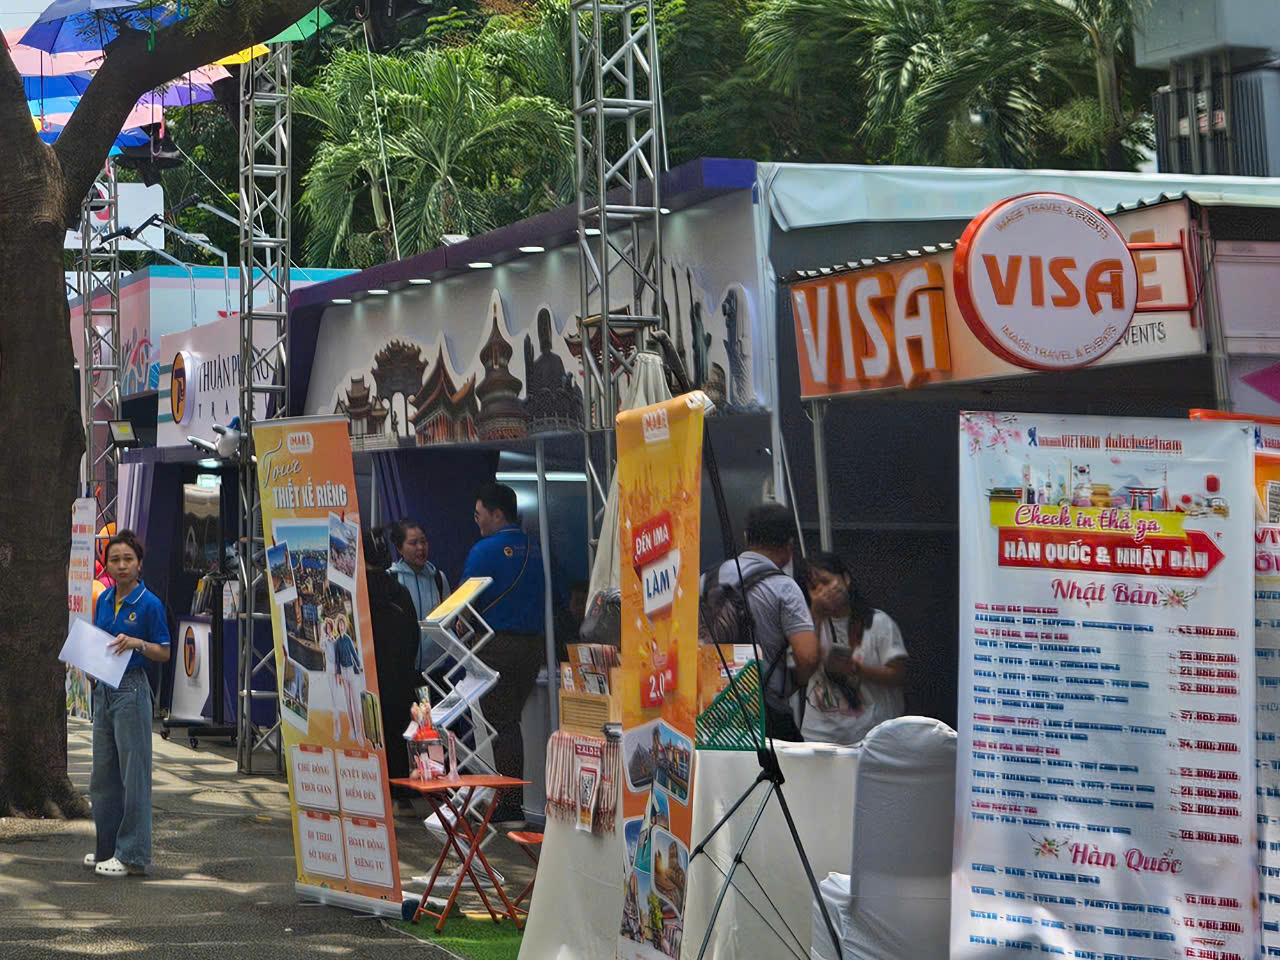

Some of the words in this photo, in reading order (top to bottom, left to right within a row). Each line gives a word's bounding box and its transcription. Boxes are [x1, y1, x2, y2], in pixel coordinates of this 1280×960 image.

[981, 253, 1126, 316] VISA
[794, 269, 946, 388] VISA
[262, 439, 302, 488] Tour
[272, 479, 300, 508] THIẾT
[301, 476, 315, 508] KẾ
[315, 479, 348, 508] RIÊNG
[635, 529, 652, 555] ĐẾN
[653, 524, 670, 546] IMA
[1014, 504, 1071, 527] Check
[1076, 511, 1095, 530] in
[1095, 507, 1132, 531] thả
[1133, 518, 1160, 544] ga
[1004, 537, 1040, 561] HÀN
[1045, 539, 1091, 563] QUỐC
[1095, 549, 1111, 564] &
[1116, 545, 1165, 573] NHẬT
[646, 569, 670, 599] LÀM
[1051, 578, 1105, 607] Nhật
[1112, 582, 1159, 605] Bản
[1067, 842, 1117, 868] Hàn
[1123, 847, 1184, 874] Quốc
